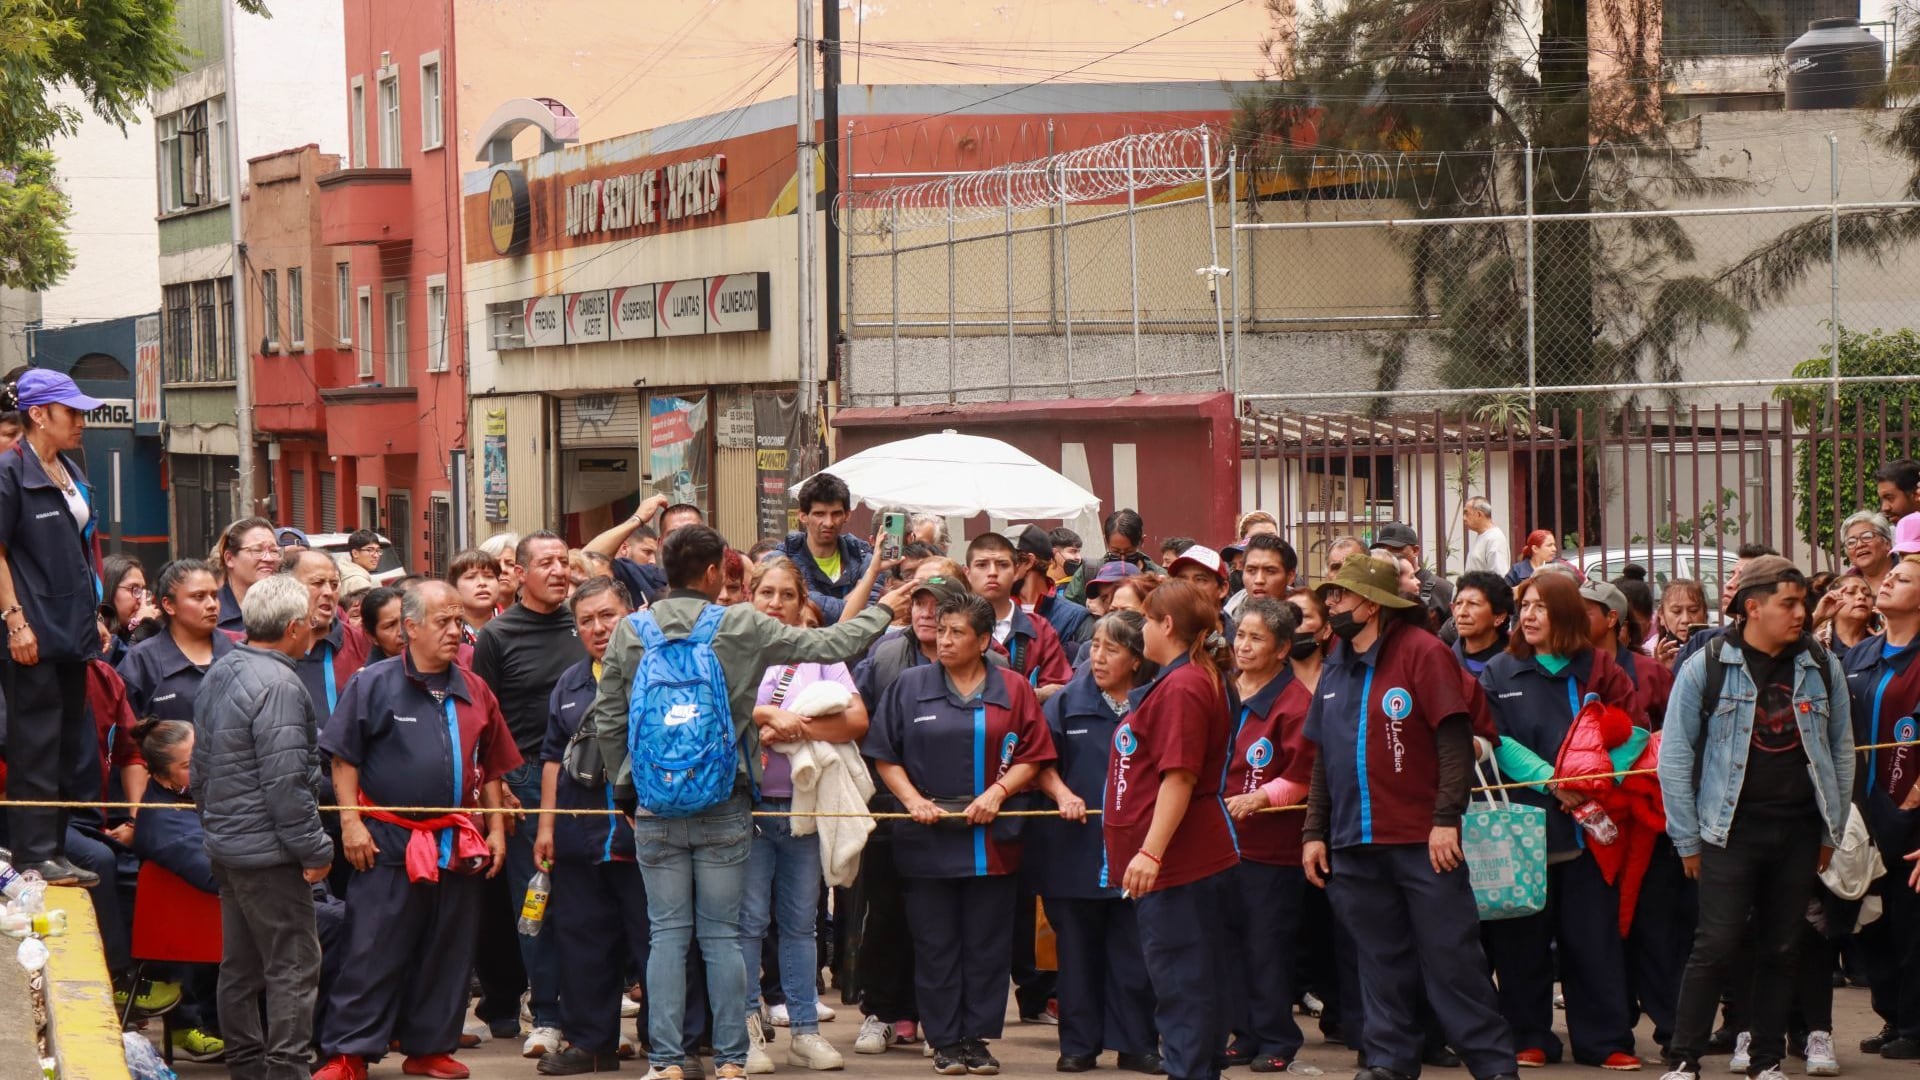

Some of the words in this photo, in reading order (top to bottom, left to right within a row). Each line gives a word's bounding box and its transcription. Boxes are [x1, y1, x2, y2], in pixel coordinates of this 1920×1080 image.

[566, 180, 602, 236] AUTO
[602, 169, 656, 232] SERVICE
[578, 298, 598, 316] CAMBIO
[672, 295, 700, 317] LLANTAS
[720, 290, 757, 313] ALINEACION
[535, 310, 556, 330] FRENOS
[584, 318, 601, 336] ACEITE
[671, 704, 698, 717] NIKE
